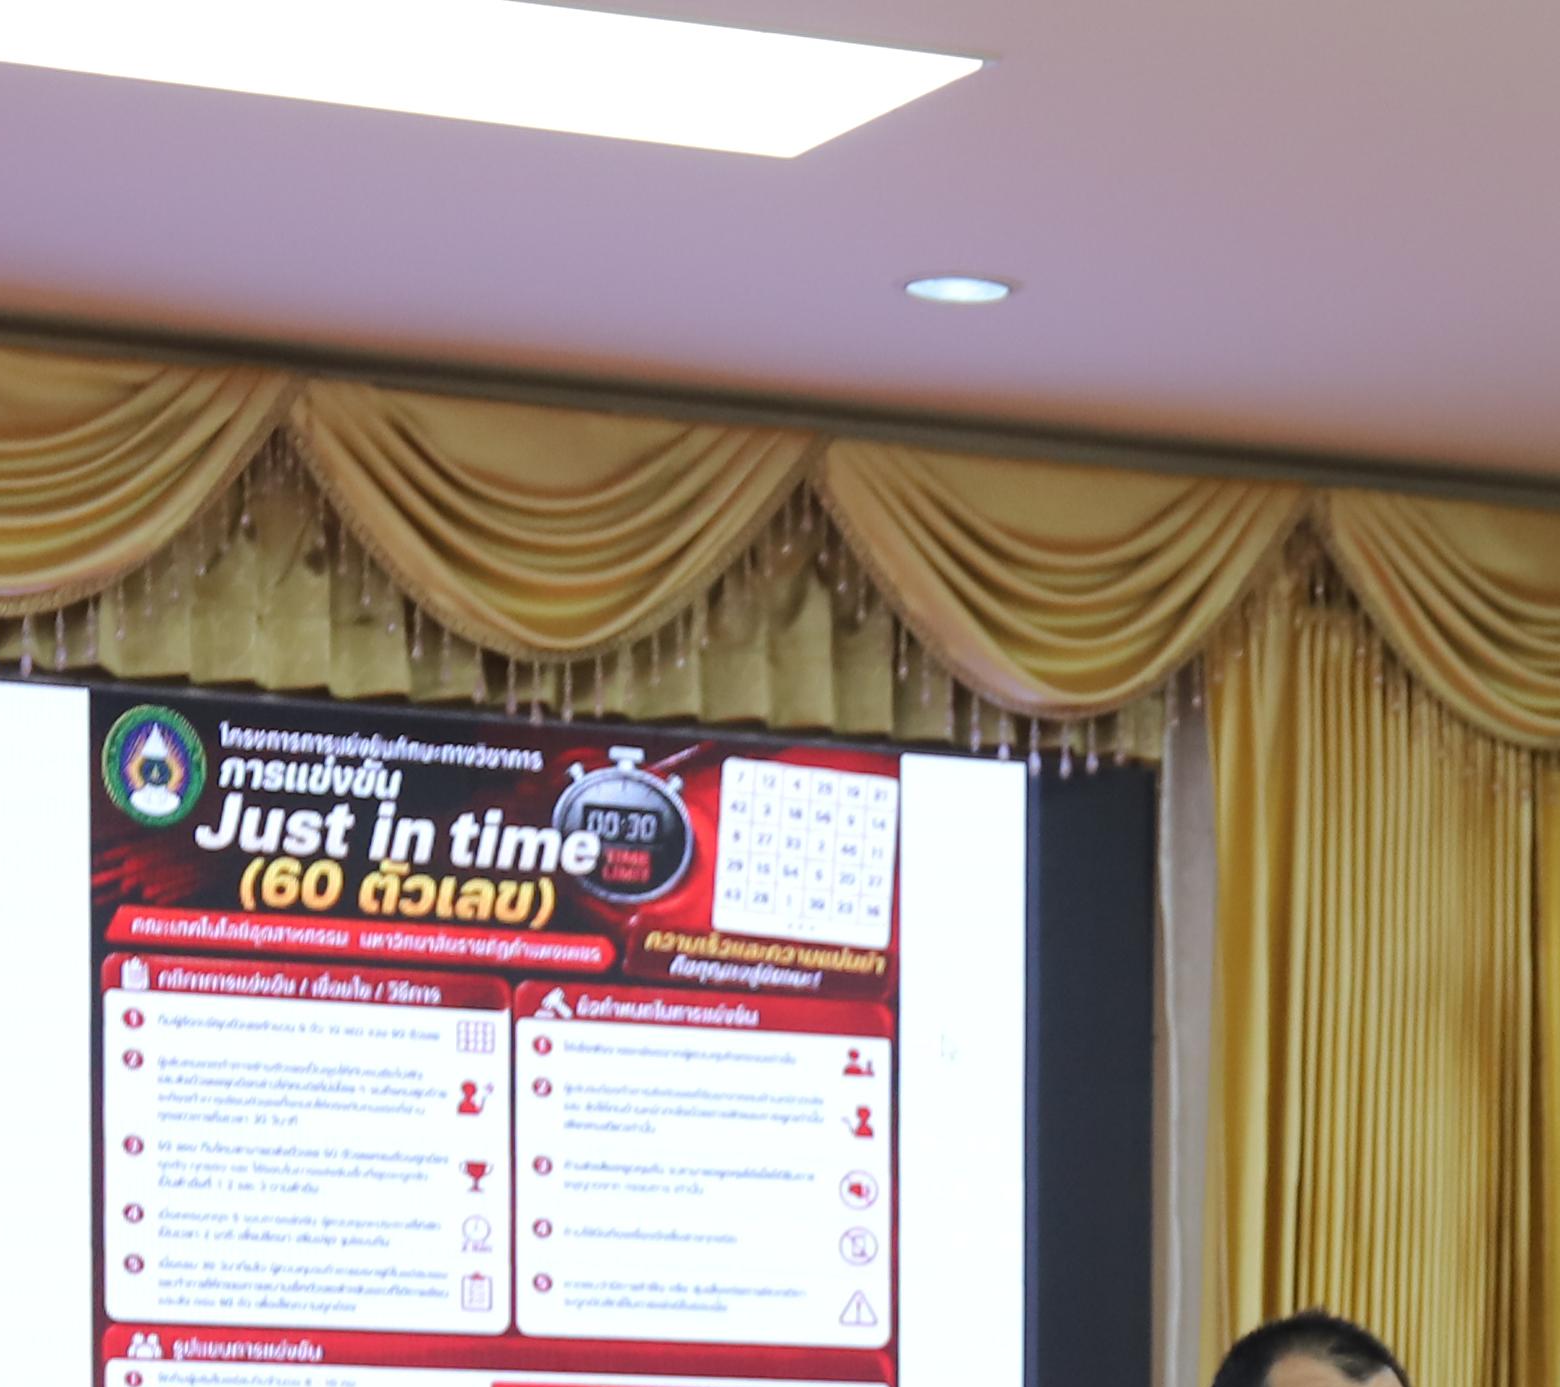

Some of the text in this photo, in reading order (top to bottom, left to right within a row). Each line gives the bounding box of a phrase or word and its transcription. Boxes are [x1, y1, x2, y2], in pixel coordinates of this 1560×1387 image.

[218, 755, 403, 800] การแข่งขัน
[195, 791, 602, 876] Just in time
[239, 856, 556, 930] (60 ตัวเลข)
